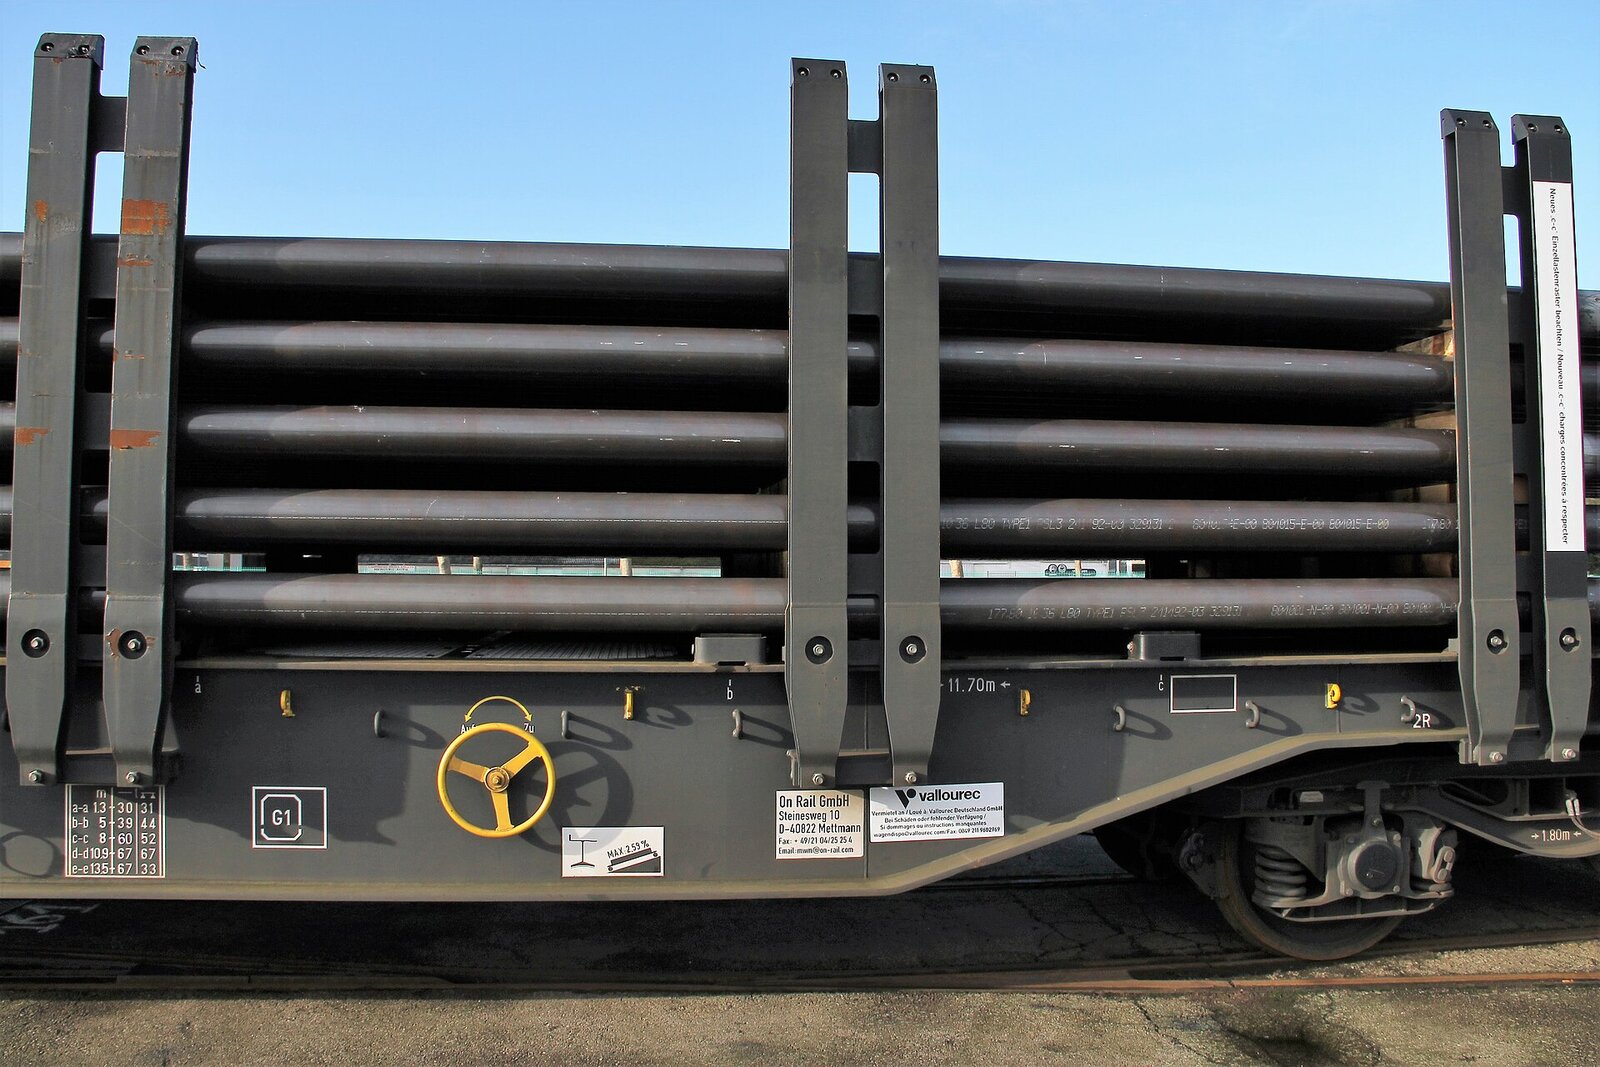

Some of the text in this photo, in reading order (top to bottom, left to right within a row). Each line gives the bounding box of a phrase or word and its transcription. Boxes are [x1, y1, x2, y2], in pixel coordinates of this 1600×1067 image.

[1551, 235, 1561, 308] Einzellastenraster
[1555, 310, 1563, 347] beachten
[1556, 354, 1564, 390] Nouveau
[1557, 411, 1566, 445] charges
[1560, 446, 1568, 496] concentrées
[1560, 505, 1569, 544] respecter
[194, 682, 202, 694] a
[947, 677, 996, 693] 11.70m
[726, 687, 733, 700] b
[1412, 714, 1431, 728] 2R
[779, 794, 849, 808] On Rail GmbH
[919, 788, 981, 802] vallourec
[72, 804, 89, 814] a-a
[117, 802, 133, 814] 30
[140, 802, 154, 814] 31
[928, 807, 953, 815] Vallourec
[954, 806, 986, 814] Deutschland
[271, 809, 292, 826] G1
[778, 809, 840, 822] Steinesweg 10
[956, 813, 983, 822] Verfügung
[72, 817, 156, 829] b-b 5 39 44
[779, 823, 861, 834] D-40822 Mettmann
[886, 822, 916, 831] dommages
[955, 820, 987, 828] manquantes
[72, 833, 156, 844] c-c 8 60 52
[1541, 829, 1570, 842] 1.80m
[72, 848, 89, 859] d-d
[117, 848, 133, 859] 67
[140, 848, 156, 859] 67
[72, 865, 89, 874] e-e
[117, 863, 133, 874] 67
[140, 863, 156, 874] 33
